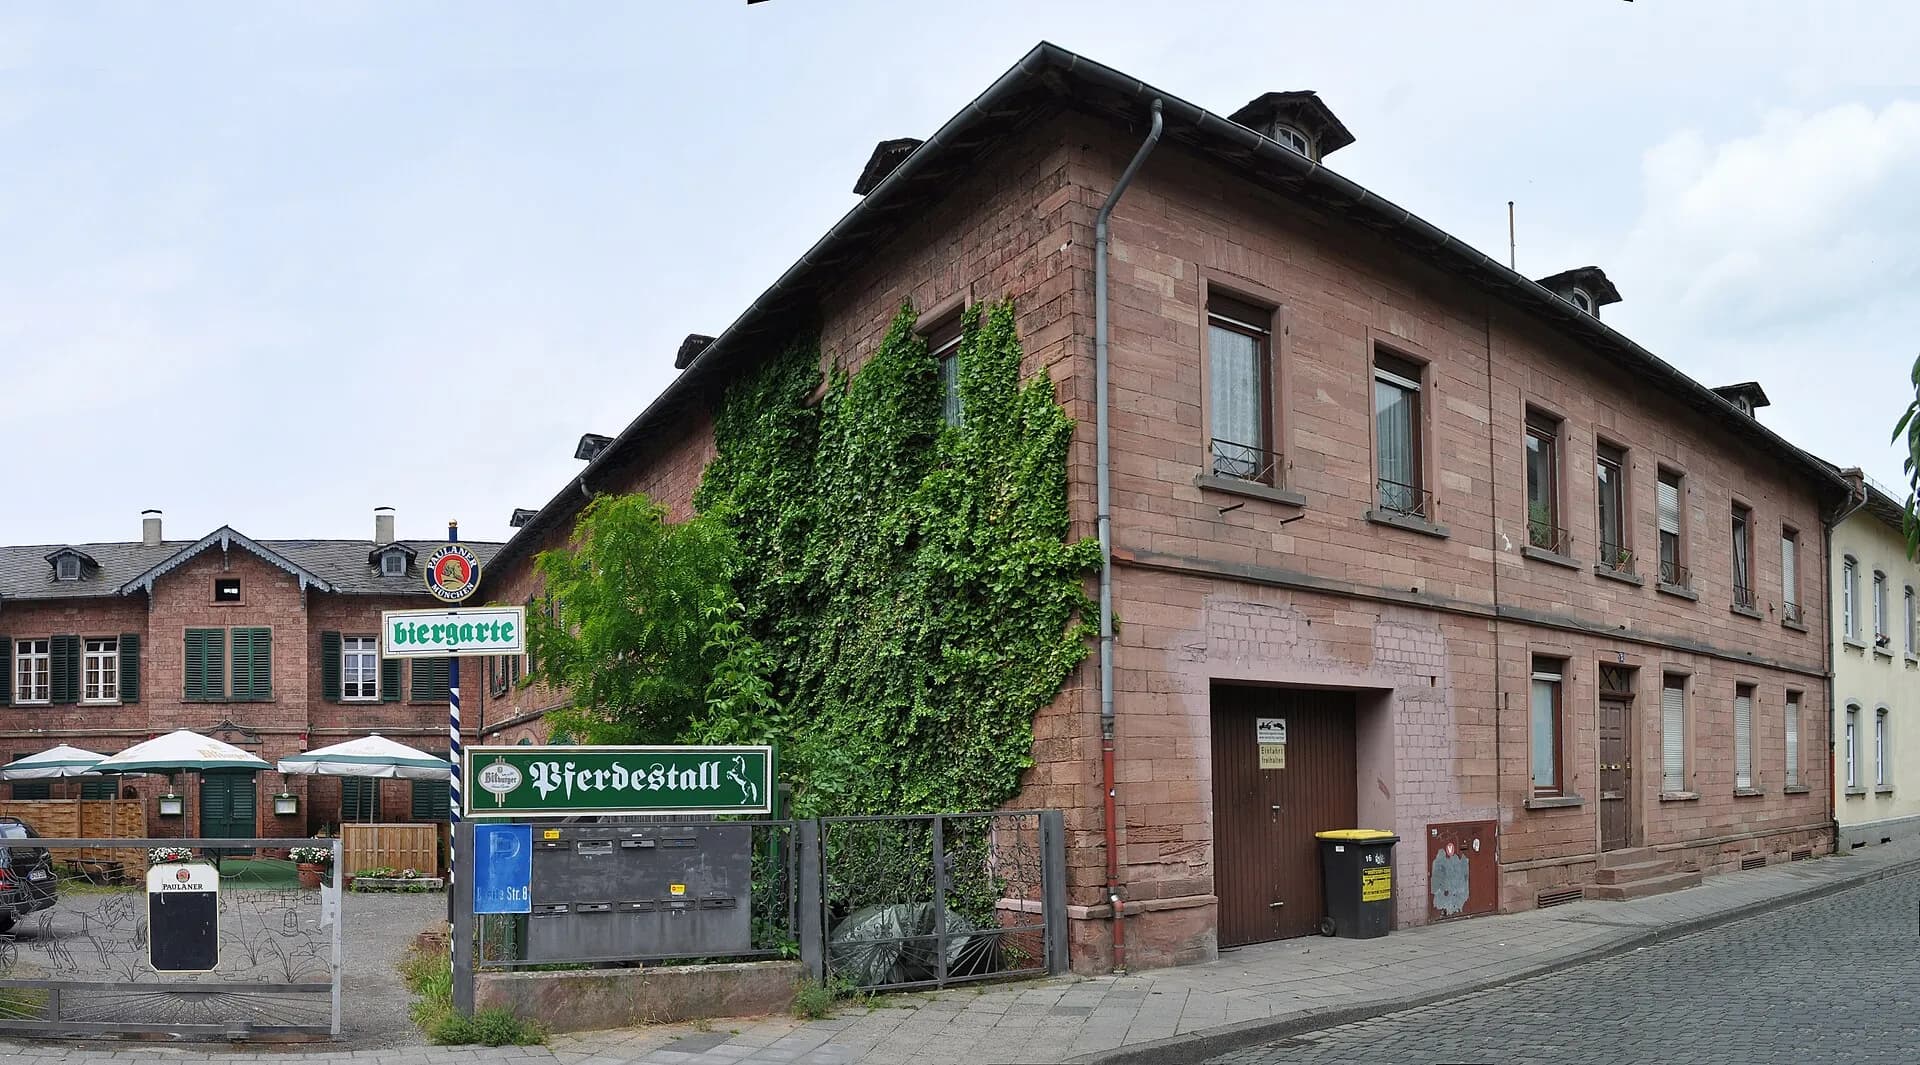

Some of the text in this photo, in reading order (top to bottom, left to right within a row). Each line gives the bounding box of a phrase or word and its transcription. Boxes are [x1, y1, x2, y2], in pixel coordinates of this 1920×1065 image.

[427, 545, 478, 571] PAULANER
[393, 619, 515, 646] biergarte
[484, 771, 518, 785] Bitburger
[529, 761, 721, 801] Pferdestall
[161, 883, 204, 891] PAULANER
[506, 886, 521, 901] Str.
